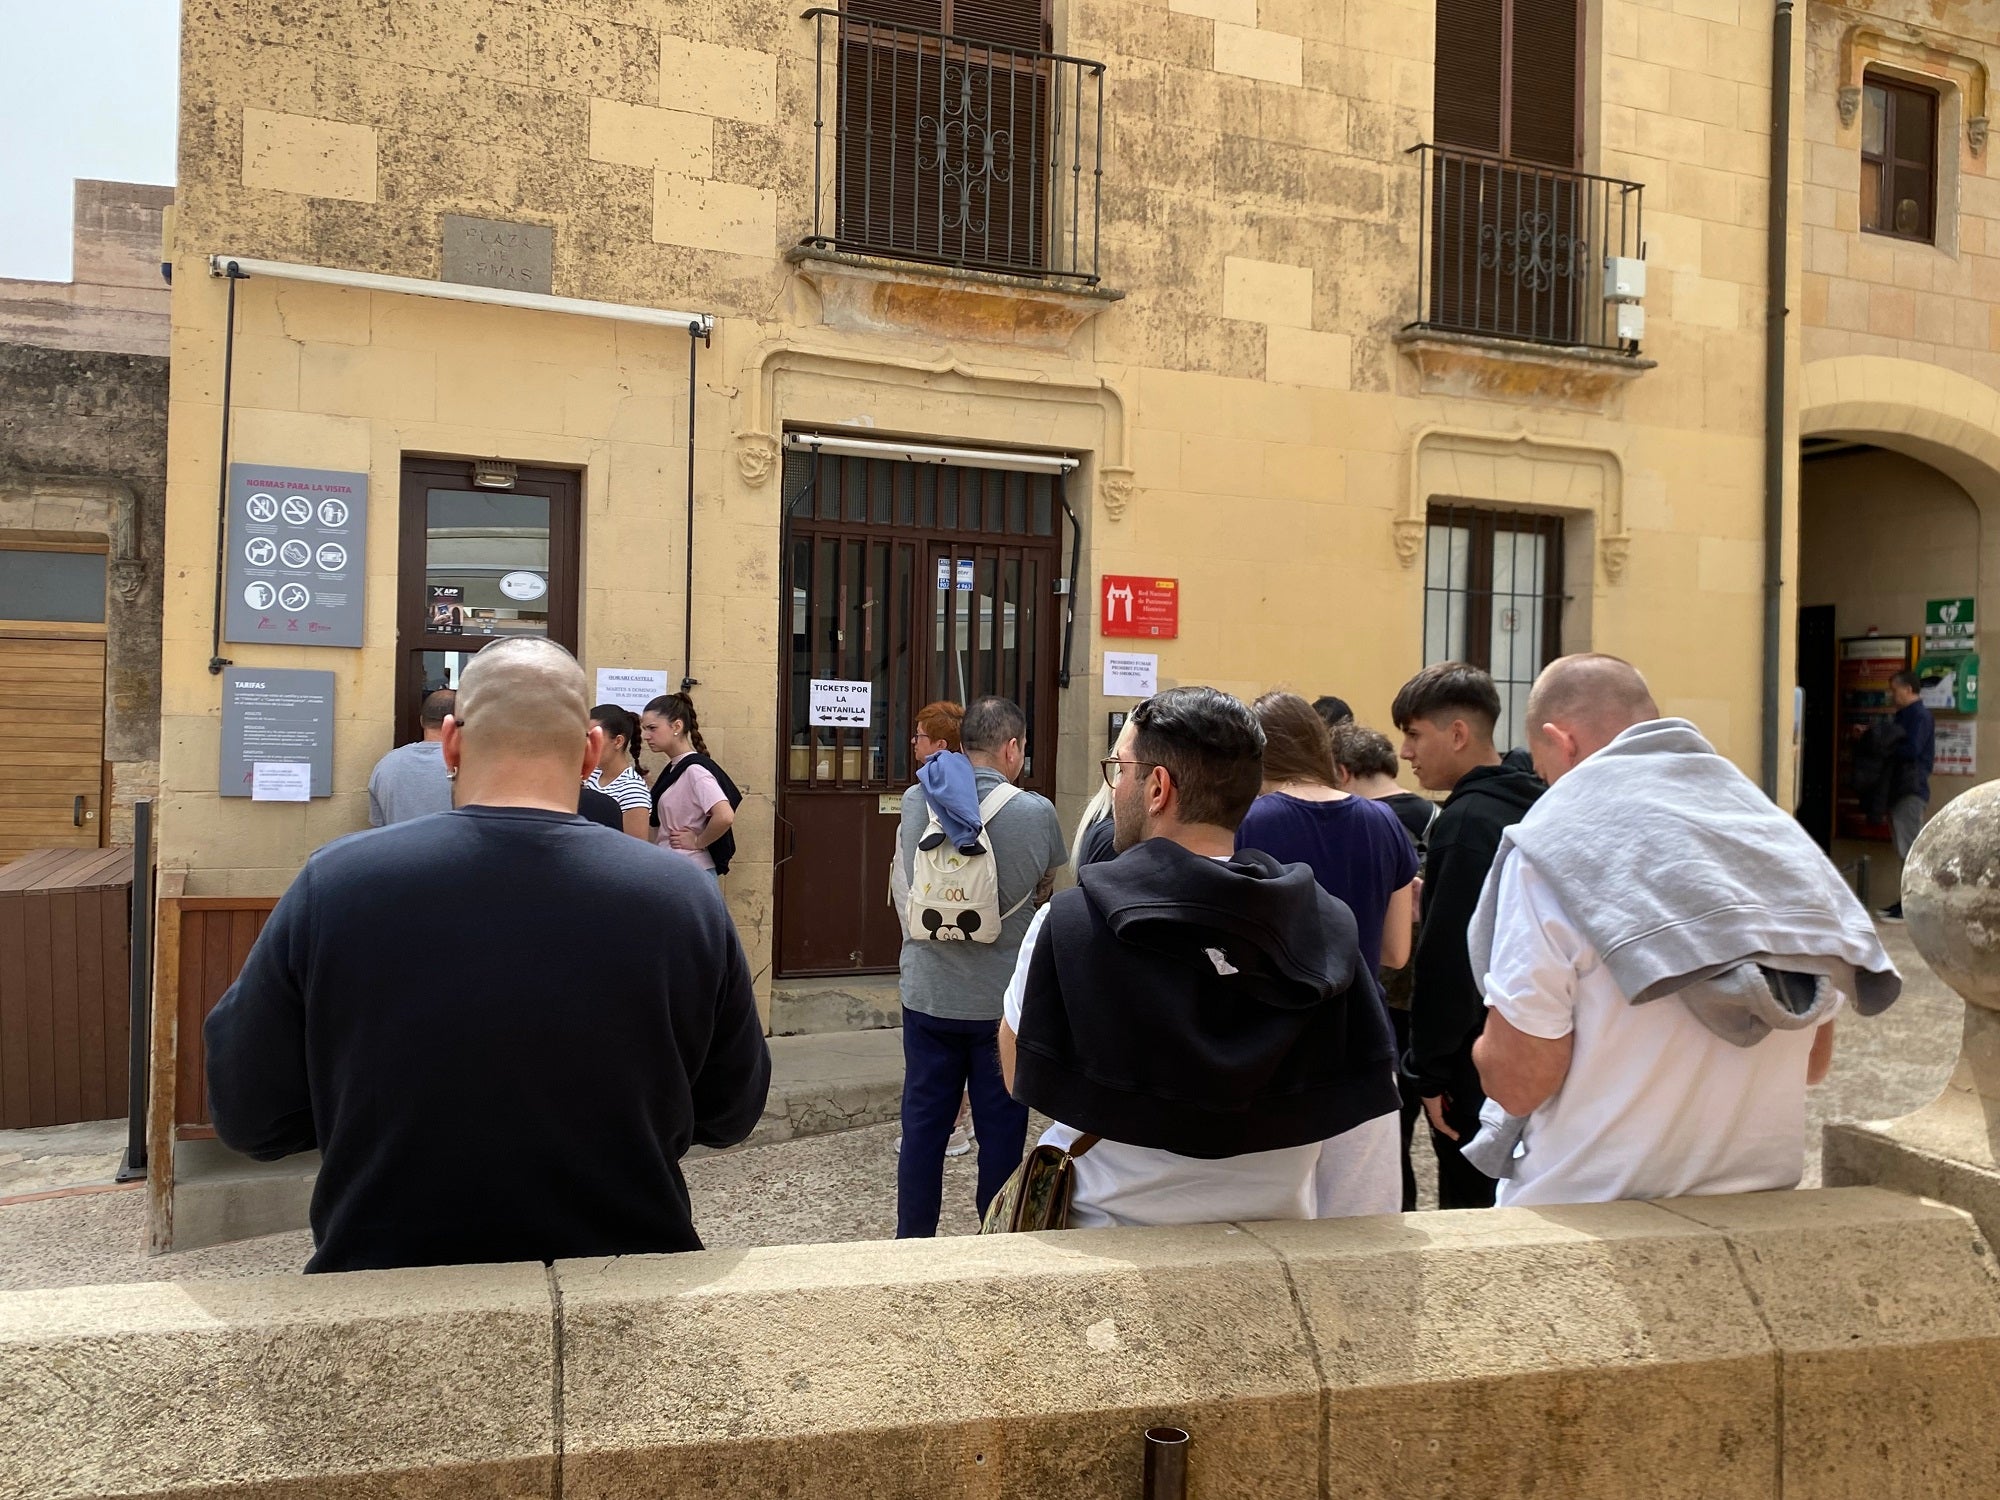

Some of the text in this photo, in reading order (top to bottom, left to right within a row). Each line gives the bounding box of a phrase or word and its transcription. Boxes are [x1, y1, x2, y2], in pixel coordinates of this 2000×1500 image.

[246, 479, 285, 488] NORMAS
[287, 482, 310, 490] PARA
[324, 485, 352, 493] VISITA
[234, 681, 266, 689] TARIFAS
[814, 684, 849, 692] TICKETS
[815, 705, 866, 714] VENTANILLA
[936, 887, 970, 902] COOL
